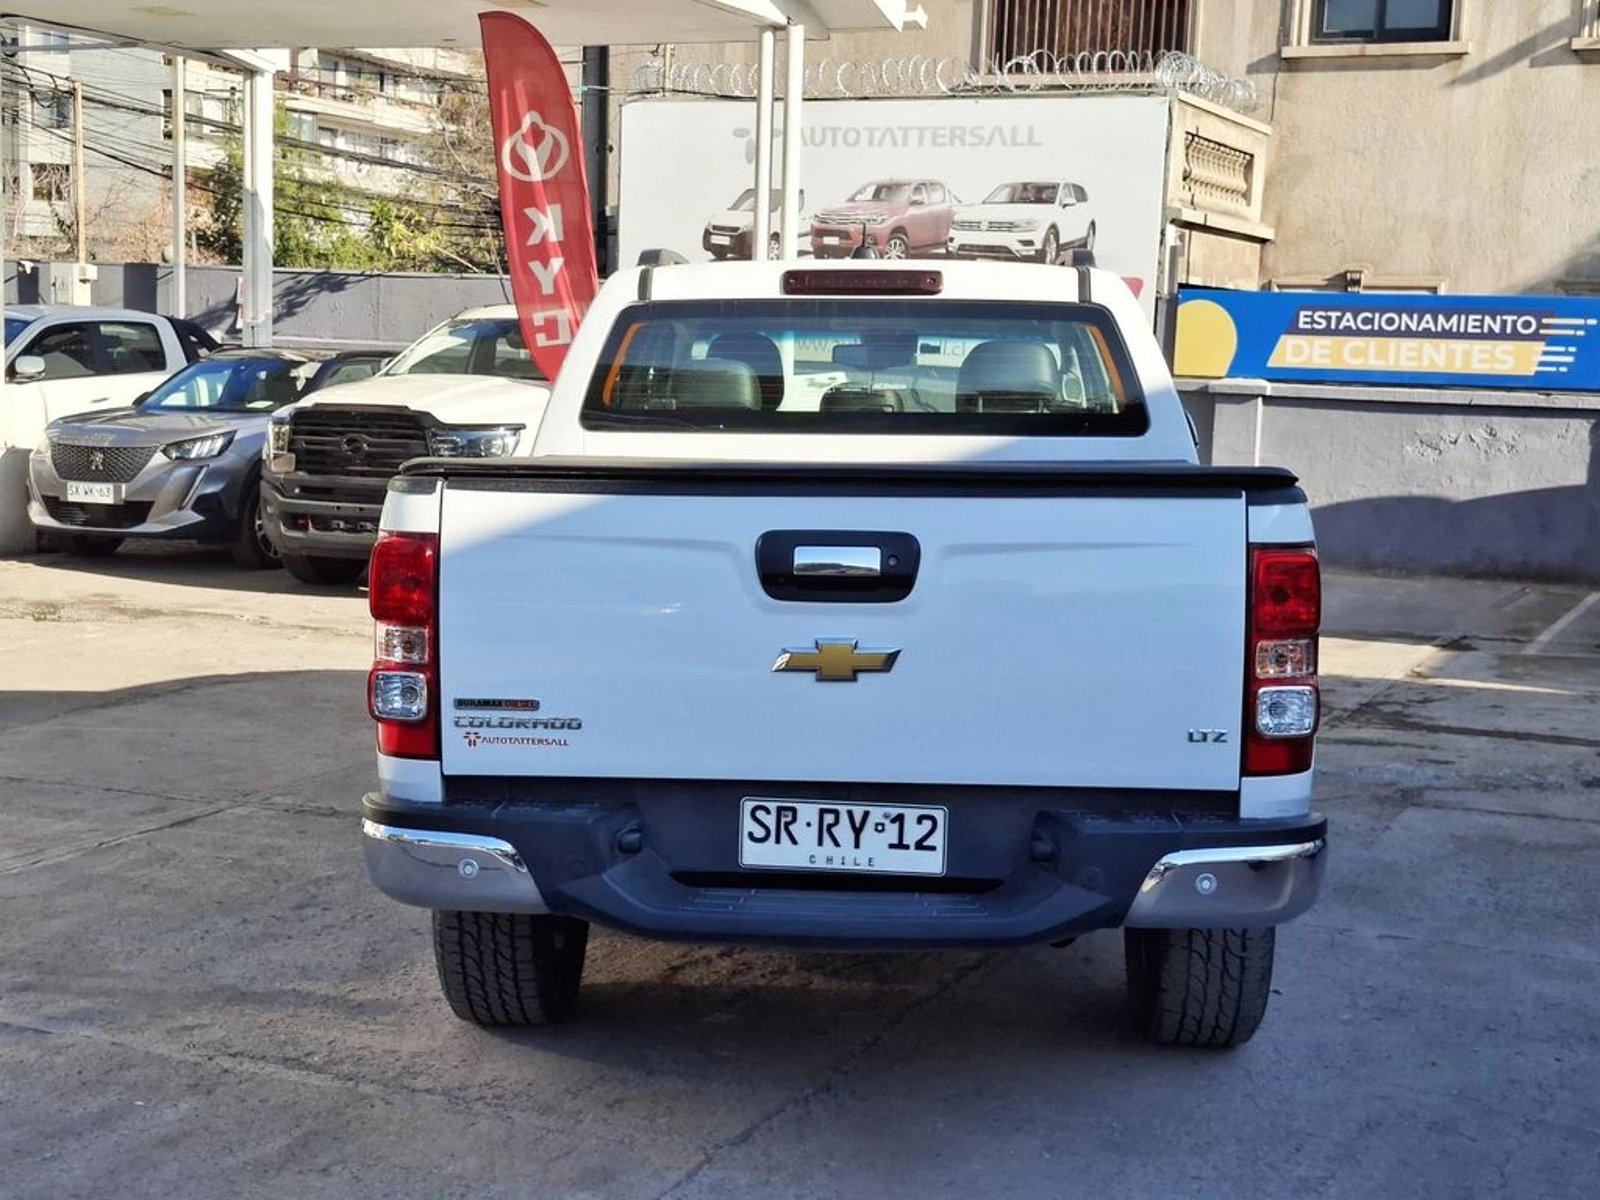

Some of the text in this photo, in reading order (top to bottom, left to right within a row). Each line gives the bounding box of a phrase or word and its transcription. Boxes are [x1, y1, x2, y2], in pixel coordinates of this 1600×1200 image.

[1297, 310, 1537, 335] ESTACIONAMIENTO
[1284, 338, 1515, 370] DE CLIENTES
[454, 716, 582, 730] COLORADO
[480, 736, 569, 746] AUTOTATTERSALL
[1187, 728, 1228, 743] LTZ
[809, 854, 875, 867] CHILE
